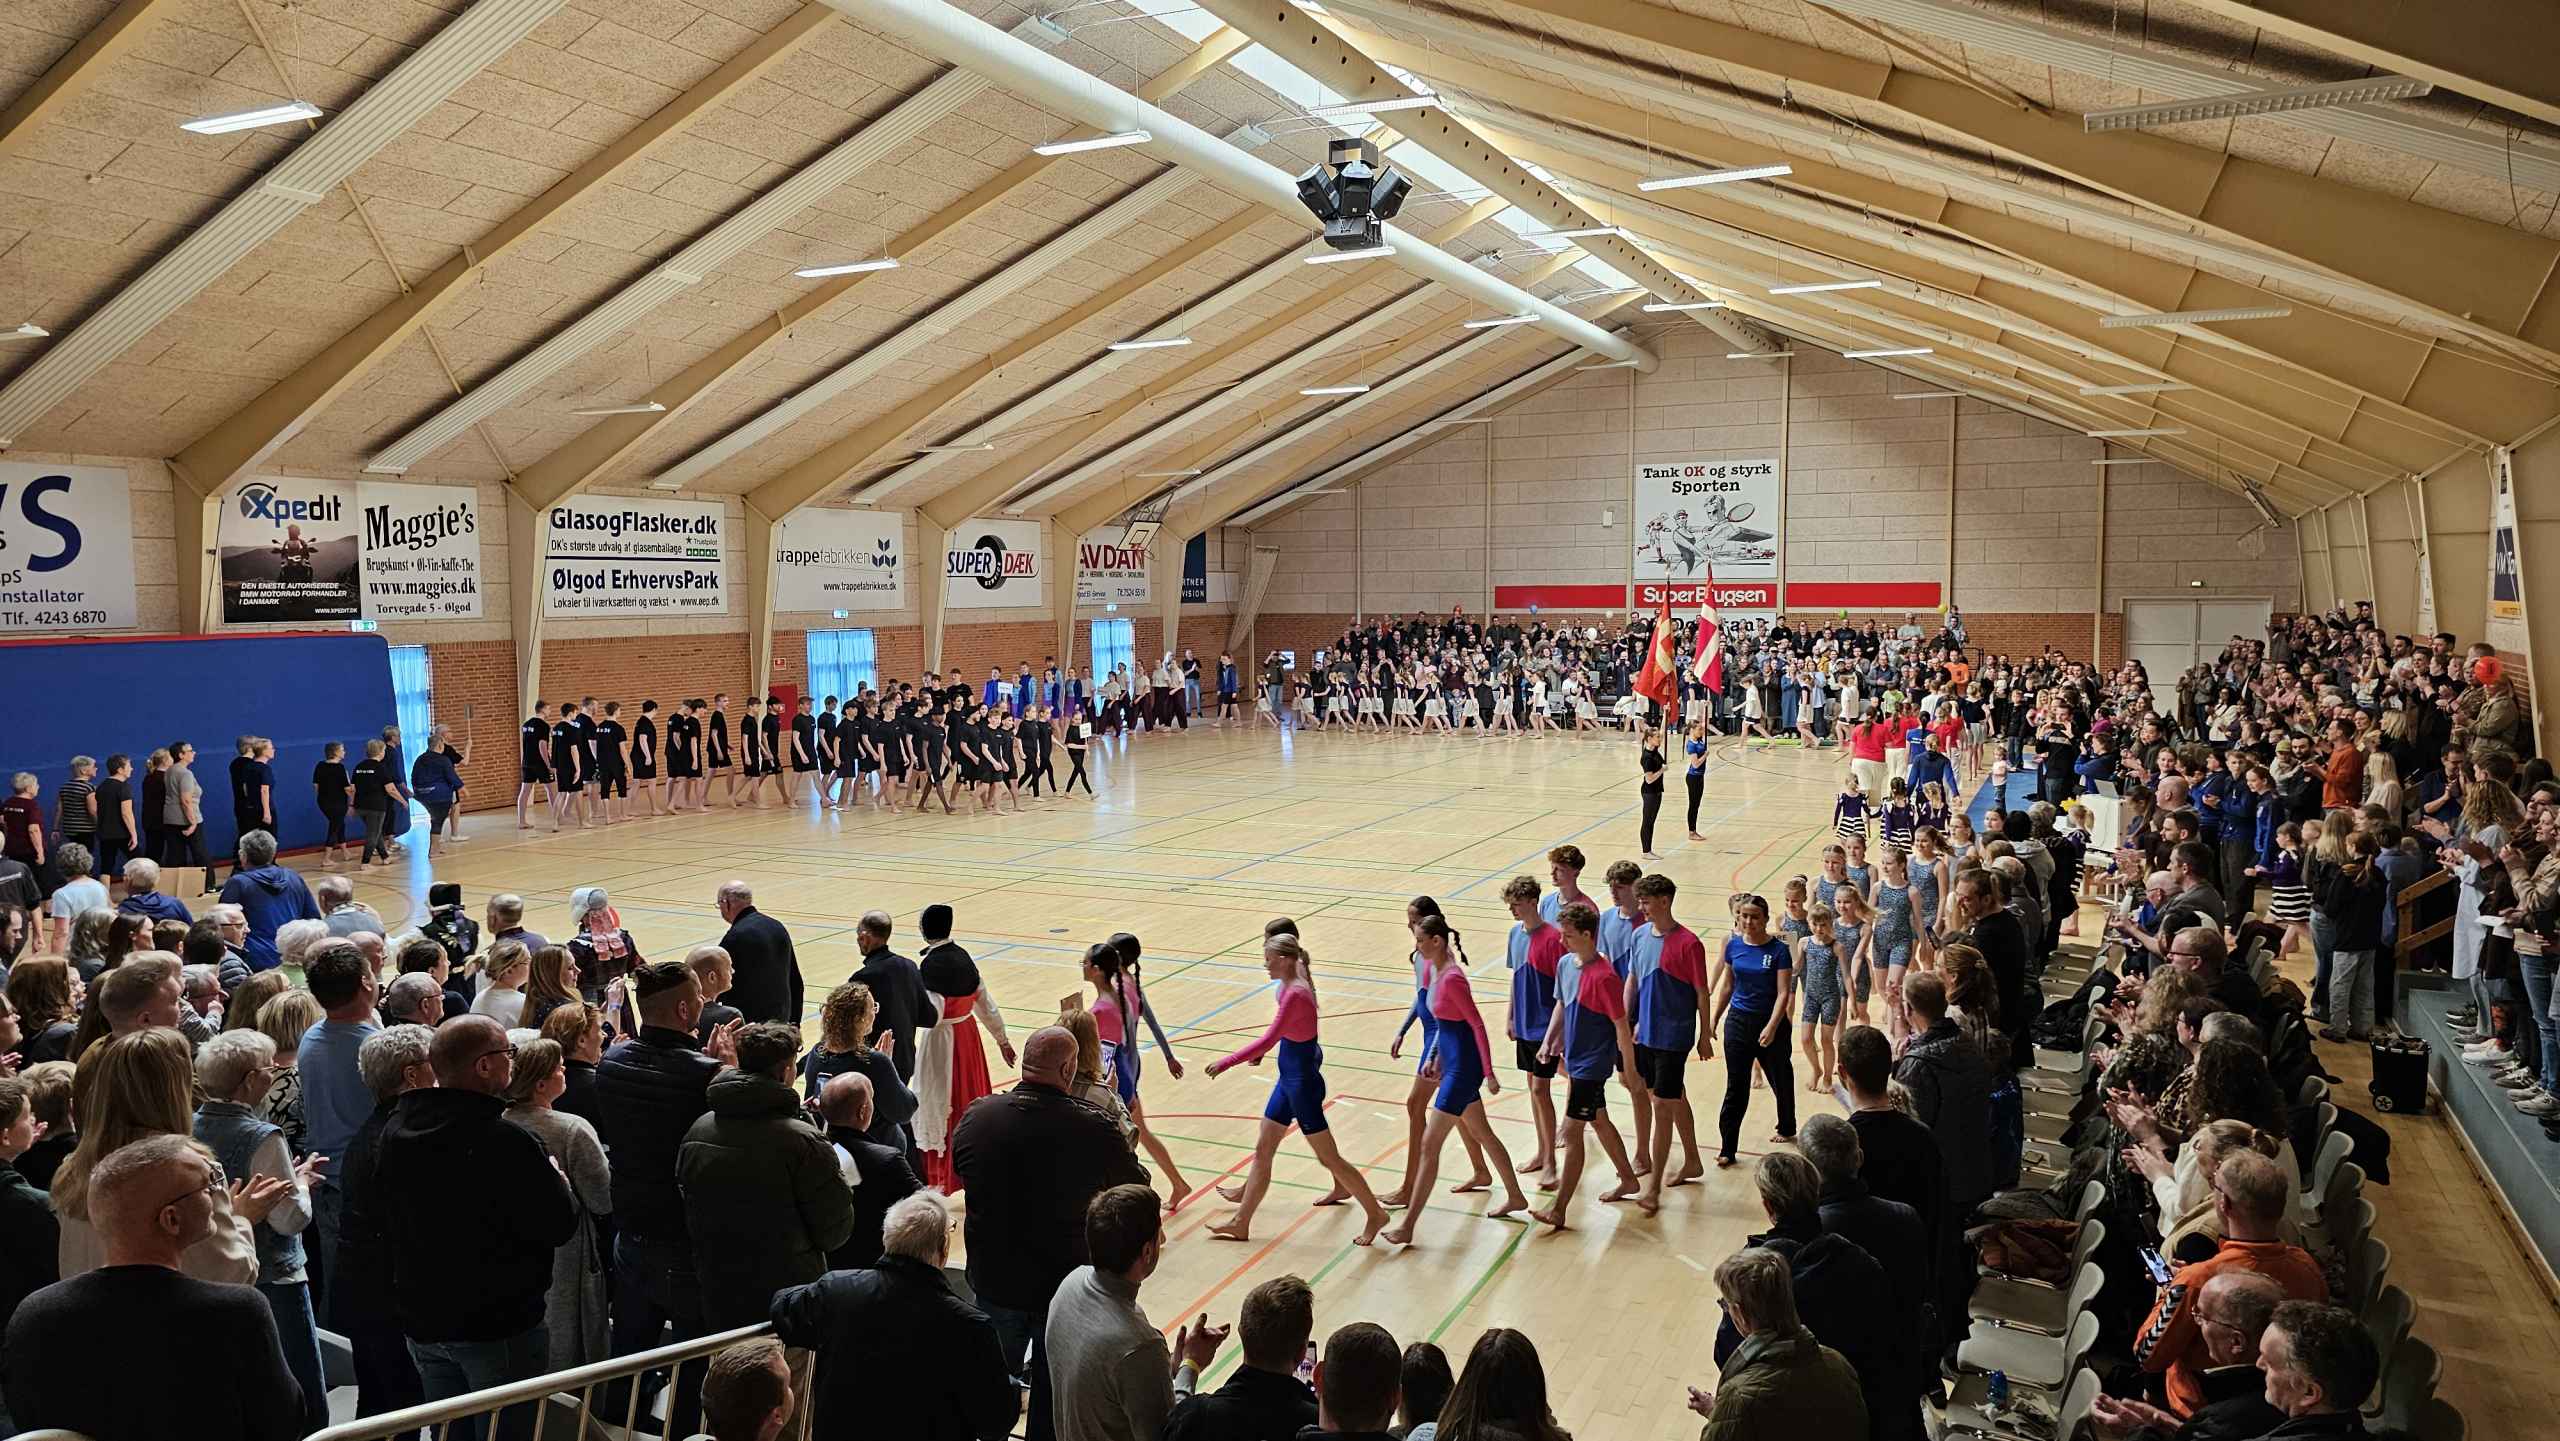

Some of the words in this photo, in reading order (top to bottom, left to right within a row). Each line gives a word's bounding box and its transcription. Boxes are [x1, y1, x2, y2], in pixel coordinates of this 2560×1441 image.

[1643, 467, 1680, 478] Tank
[1684, 466, 1705, 477] OK
[1709, 466, 1726, 479] og
[1731, 464, 1772, 478] styrk
[1672, 480, 1741, 496] Sporten
[245, 491, 341, 528] Xpedit
[364, 502, 474, 551] Maggie's
[551, 507, 717, 537] GlasogFlasker.dk
[551, 539, 568, 551] DK's
[570, 540, 596, 552] største
[598, 541, 622, 554] udvalg
[624, 541, 631, 553] af
[633, 541, 683, 555] glasemballage
[694, 538, 718, 546] Trustpilot
[776, 547, 871, 567] trappefabrikken
[947, 551, 992, 574] SUPER
[1004, 553, 1034, 574] DÆK
[366, 557, 409, 576] Brugskunst
[0, 570, 22, 586] pS
[241, 582, 257, 590] DEN
[258, 582, 286, 590] ENESTE
[287, 582, 340, 590] AUTORISEREDE
[553, 568, 606, 594] Ølgod
[612, 569, 719, 590] ErhvervsPark
[240, 590, 259, 598] BMW
[260, 590, 301, 598] MOTORRAD
[302, 590, 347, 598] FORHANDLER
[369, 577, 476, 600] www.maggies.dk
[823, 581, 897, 593] www.trappefabrikken.dk
[0, 589, 84, 603] nstallatør
[553, 597, 581, 609] Lokaler
[583, 596, 591, 608] til
[592, 596, 637, 608] iværksætteri
[638, 598, 648, 609] og
[649, 597, 669, 607] vækst
[1643, 586, 1767, 607] SuperBugsen
[376, 603, 427, 615] Torvegade
[429, 603, 435, 613] 5
[444, 602, 471, 614] Ølgod
[2, 611, 29, 625] Tlf.
[35, 611, 69, 625] 4243
[73, 611, 107, 624] 6870
